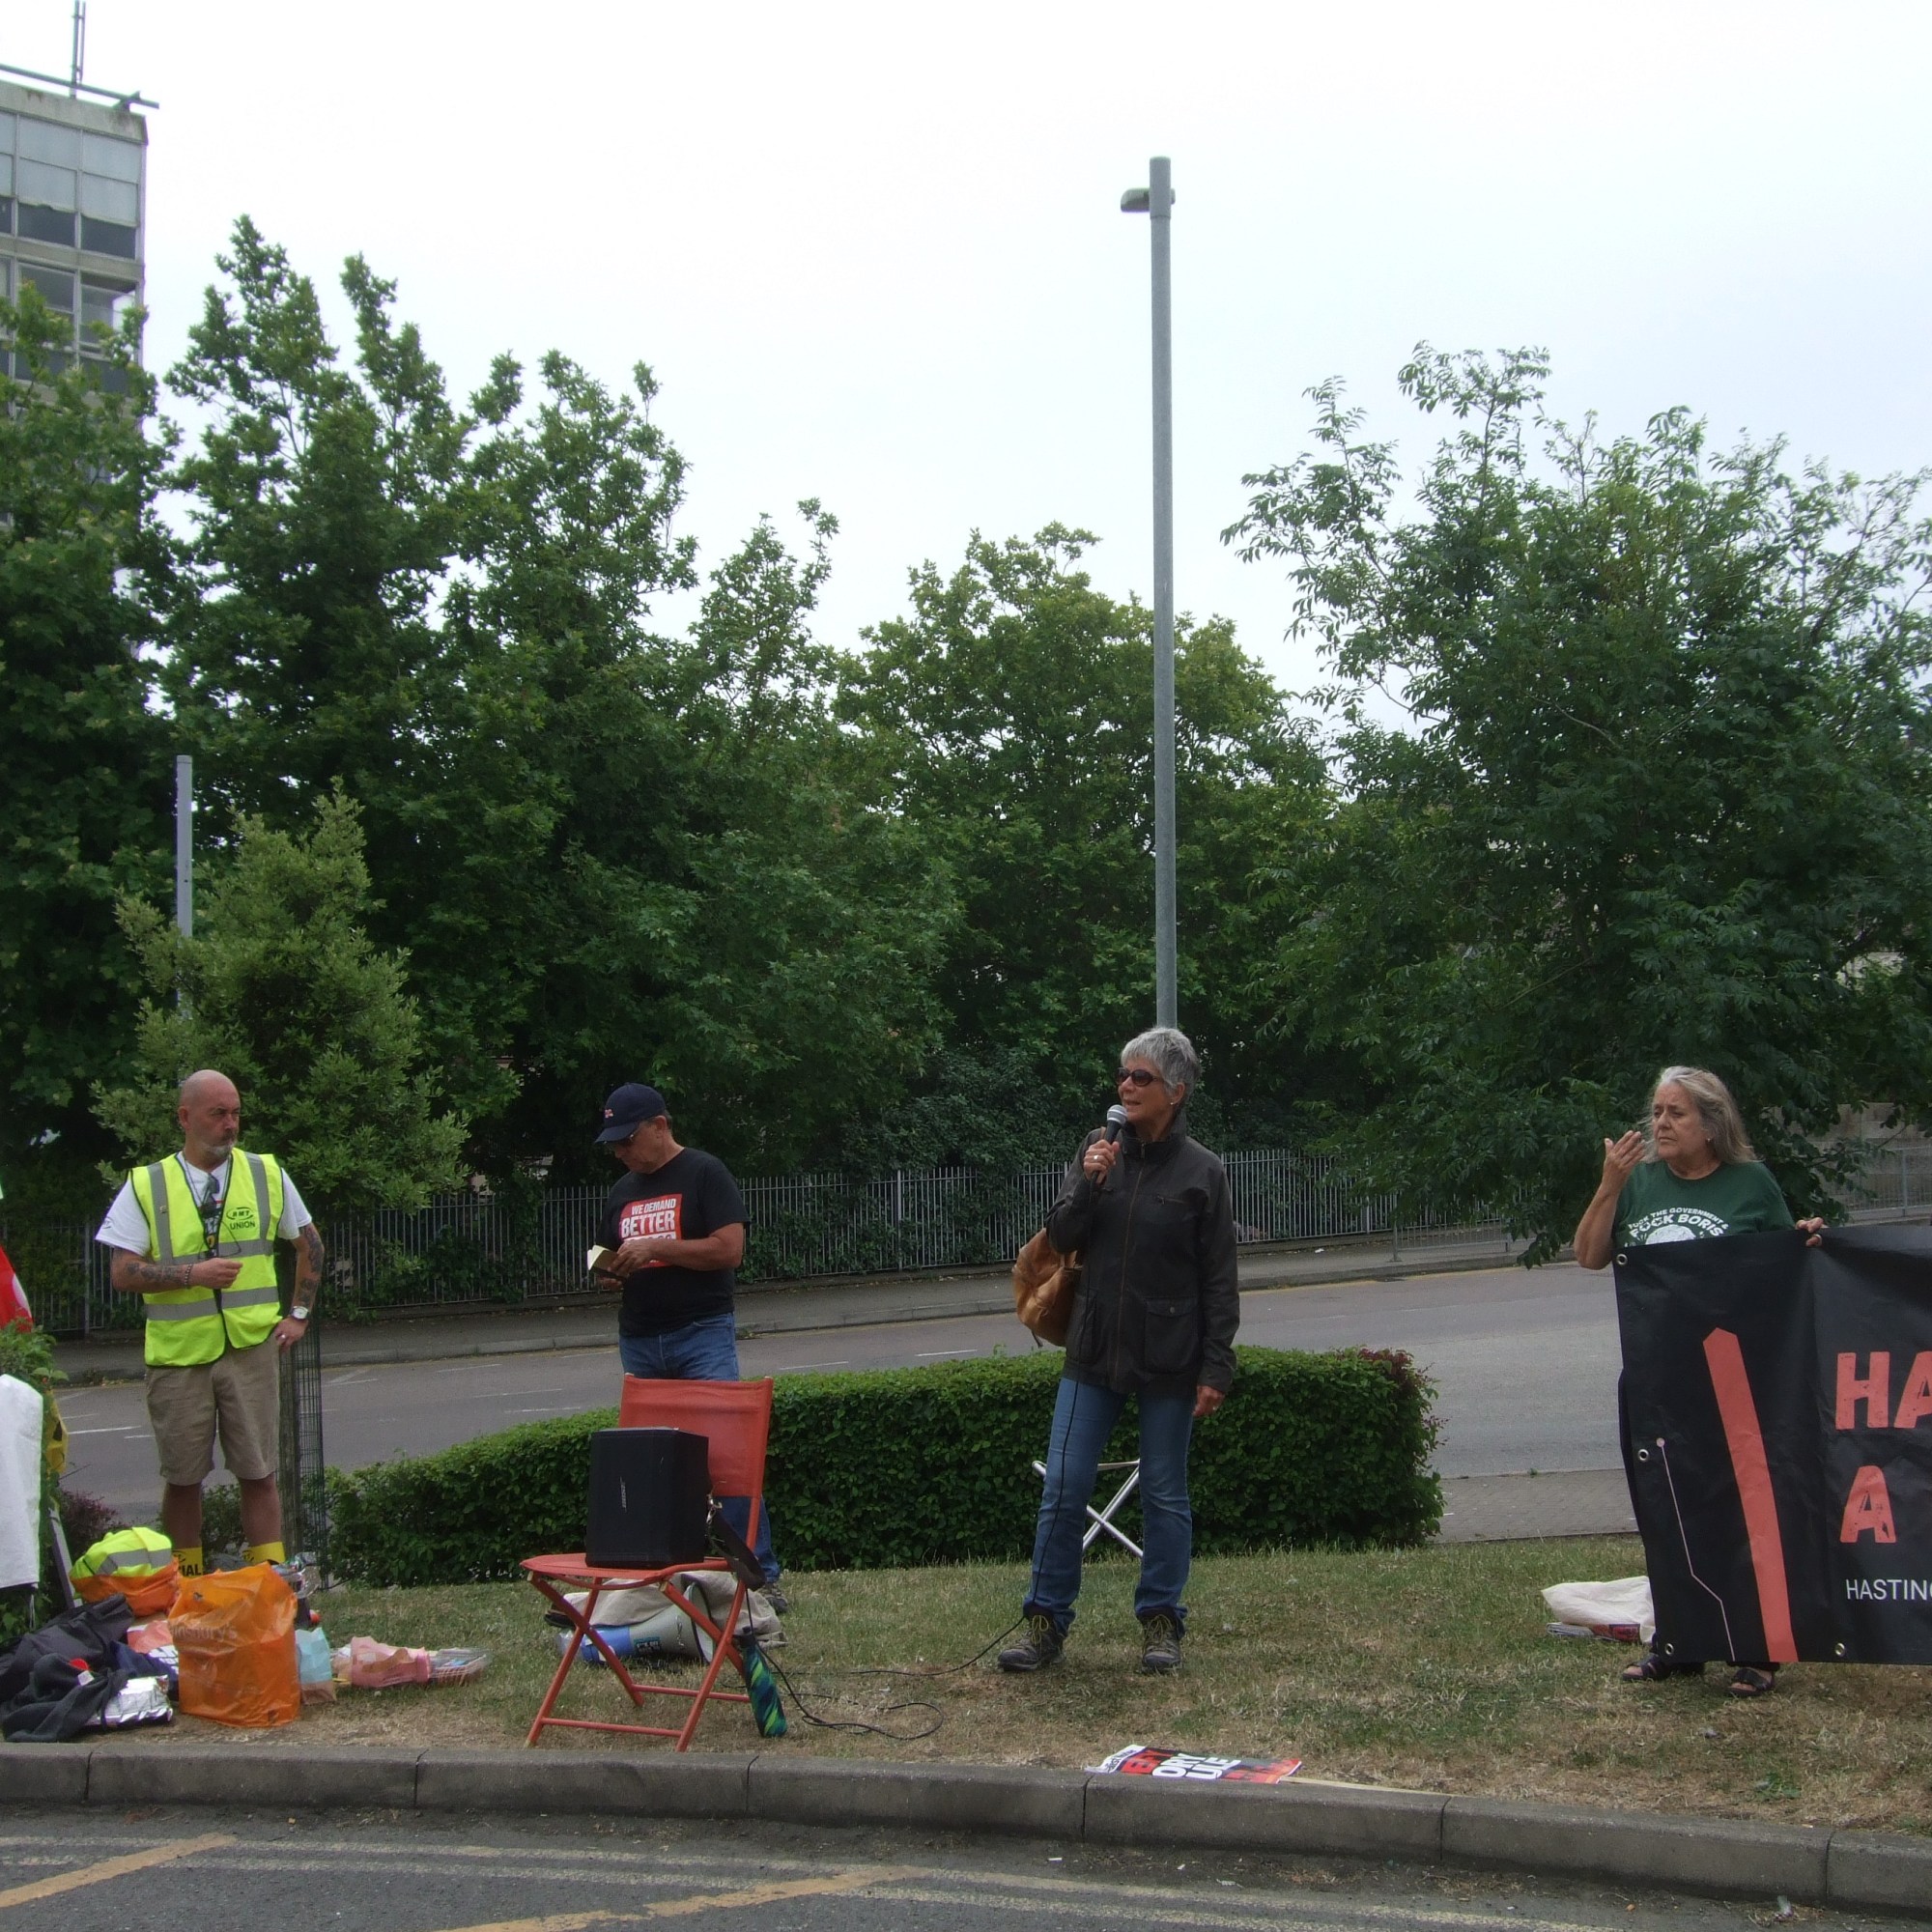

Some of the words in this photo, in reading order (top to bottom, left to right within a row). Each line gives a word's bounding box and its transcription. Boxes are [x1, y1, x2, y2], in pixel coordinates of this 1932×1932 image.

[632, 1205, 644, 1215] WE
[644, 1198, 676, 1213] DEMAND
[1650, 1208, 1668, 1218] THE
[1669, 1208, 1723, 1224] GOVERNMENT
[230, 1220, 255, 1230] UNION
[621, 1209, 675, 1238] BETTER
[1677, 1213, 1723, 1236] BORIS
[1840, 1464, 1896, 1544] A
[1845, 1578, 1932, 1601] HASTIN
